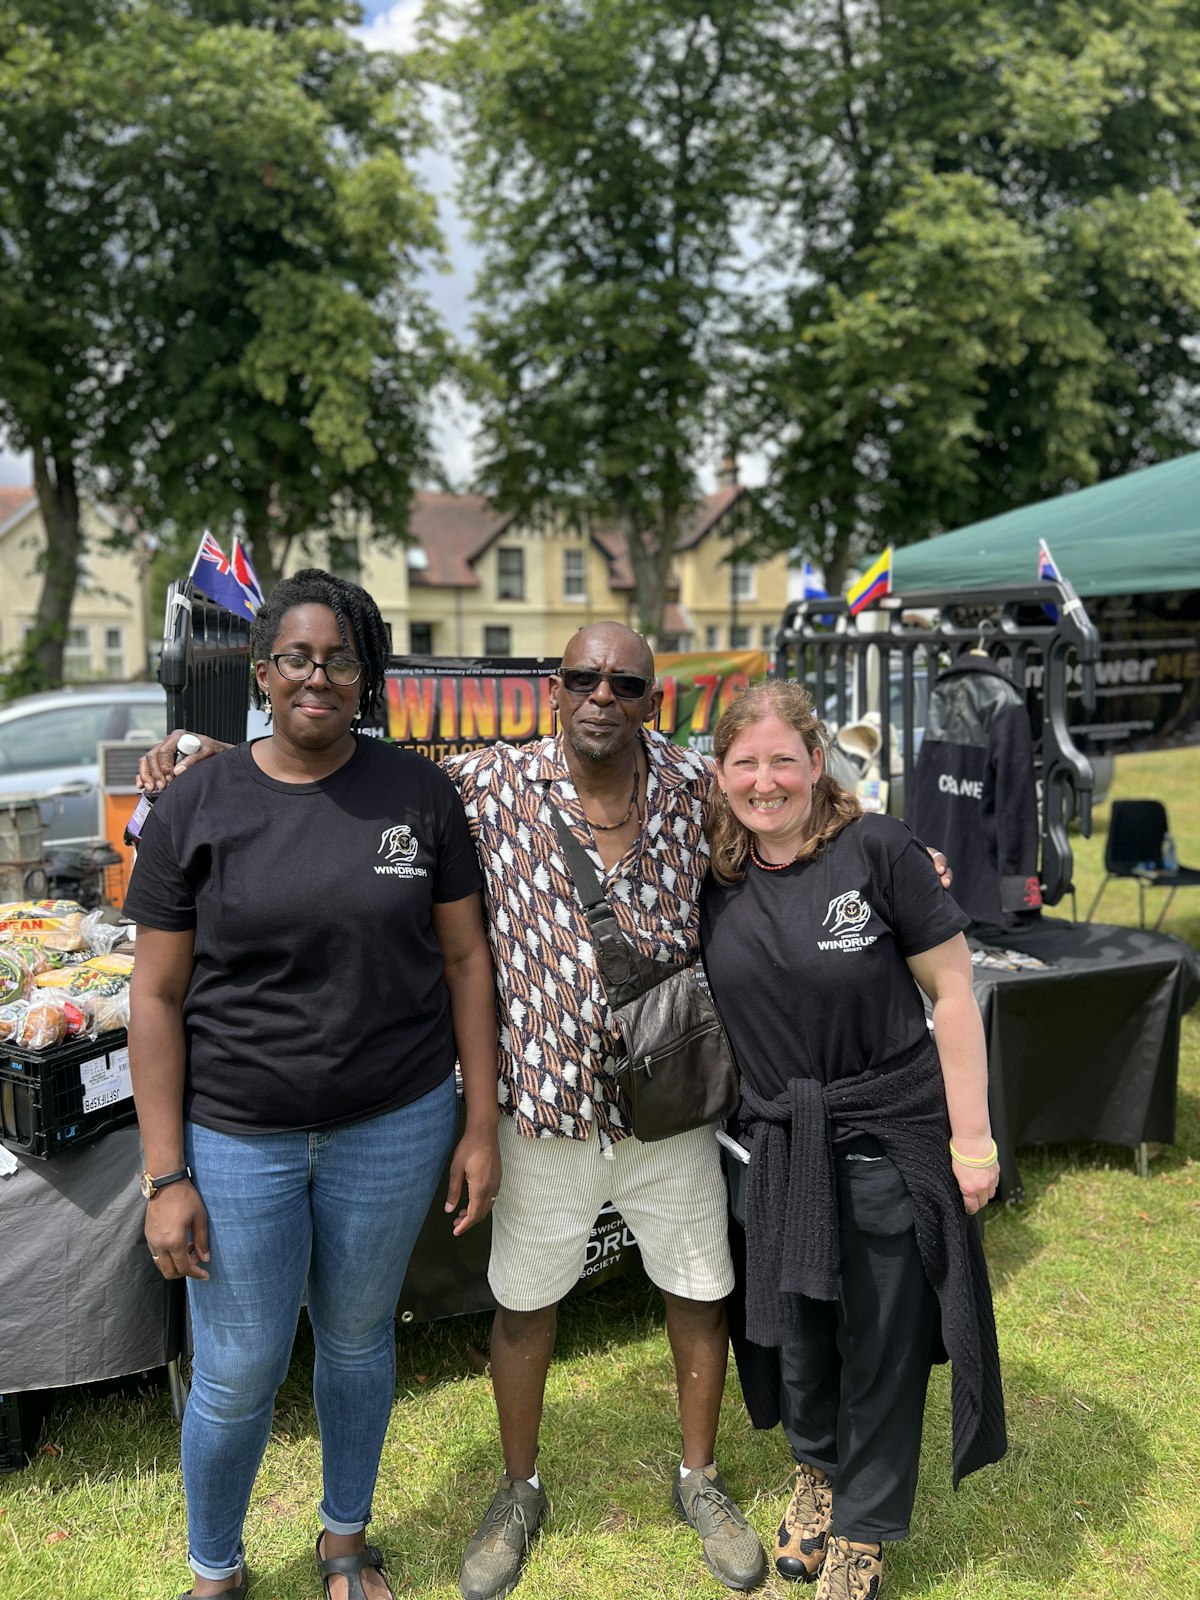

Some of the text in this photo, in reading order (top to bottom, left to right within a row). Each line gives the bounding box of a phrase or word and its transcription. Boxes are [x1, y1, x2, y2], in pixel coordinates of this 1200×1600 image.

[384, 668, 413, 676] Celebrating
[373, 866, 428, 877] WINDRUSH
[0, 920, 43, 931] BEAN
[817, 936, 878, 951] WINDRUS
[590, 1219, 624, 1237] SWICH
[580, 1254, 621, 1278] SOCIETY
